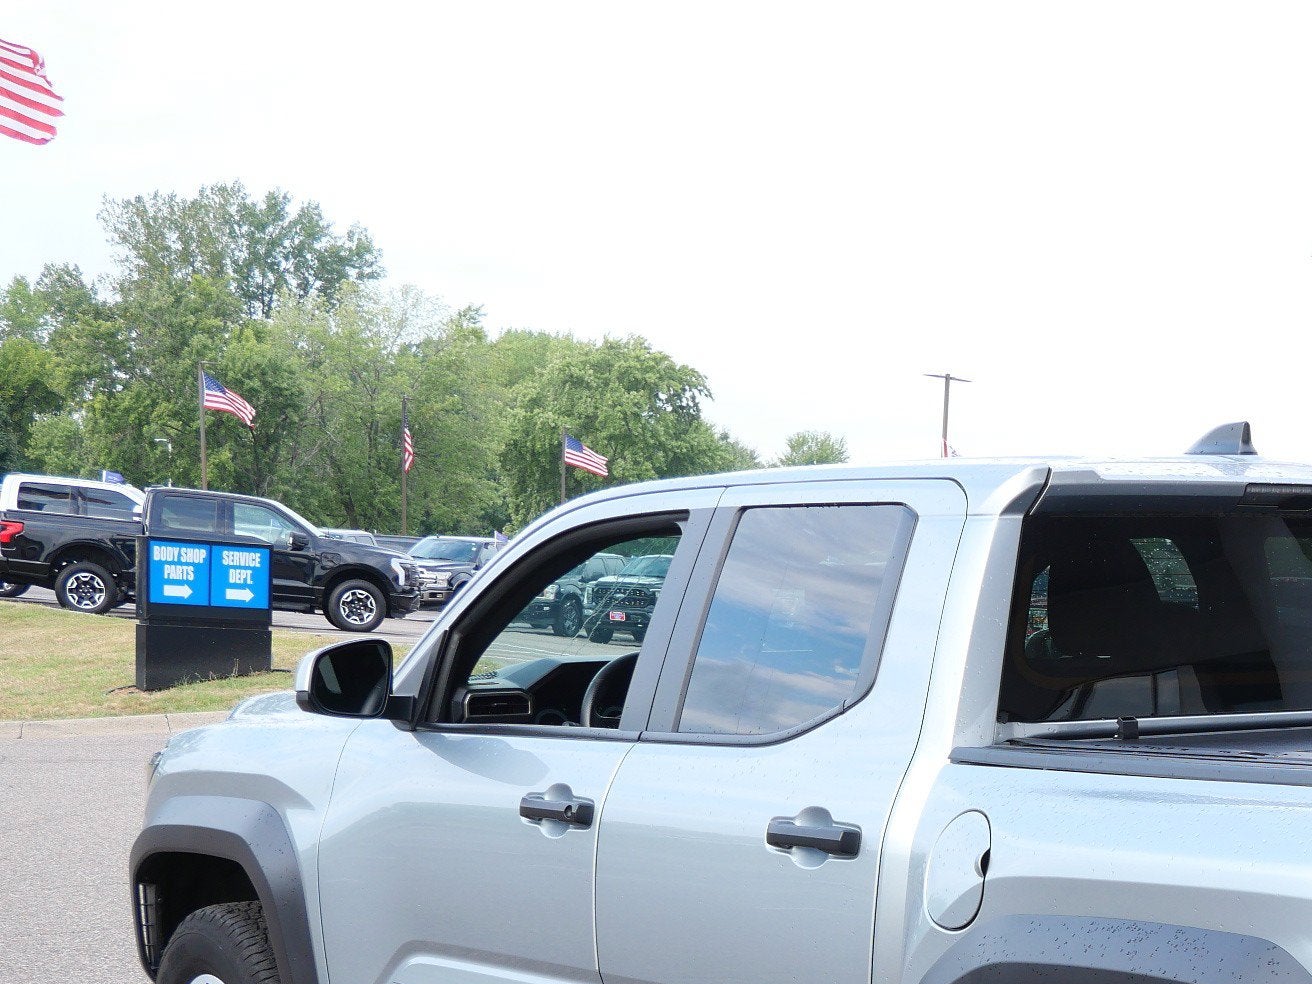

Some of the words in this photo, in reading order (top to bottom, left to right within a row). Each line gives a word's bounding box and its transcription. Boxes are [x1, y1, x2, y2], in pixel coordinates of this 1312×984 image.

[153, 546, 179, 562] BODY
[181, 547, 206, 563] SHOP
[222, 550, 261, 568] SERVICE
[164, 564, 194, 581] PARTS
[229, 569, 253, 585] DEPT.
